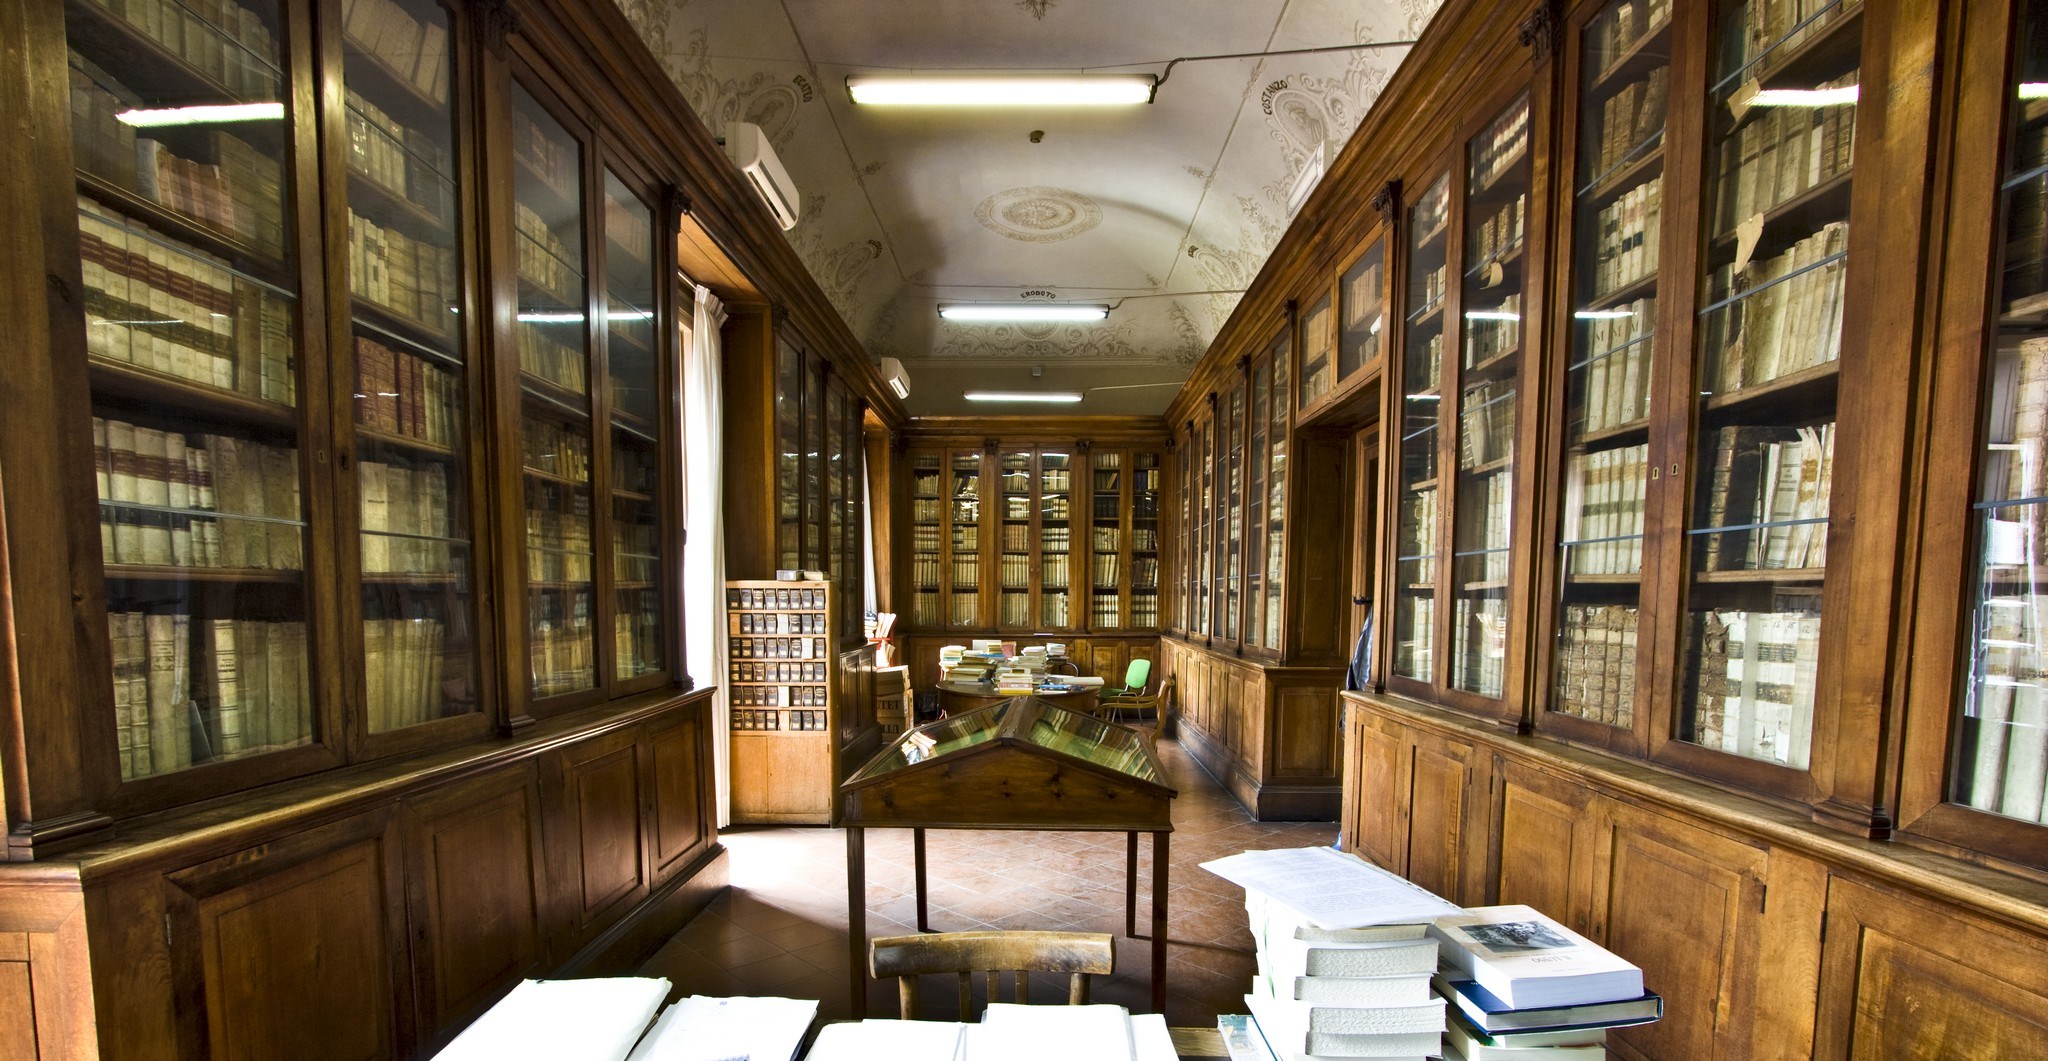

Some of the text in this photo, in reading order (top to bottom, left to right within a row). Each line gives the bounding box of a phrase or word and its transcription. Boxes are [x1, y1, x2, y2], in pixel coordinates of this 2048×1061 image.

[792, 74, 813, 103] ECATEO
[1261, 79, 1288, 115] COSTANZO
[1020, 290, 1056, 299] ERODOTO
